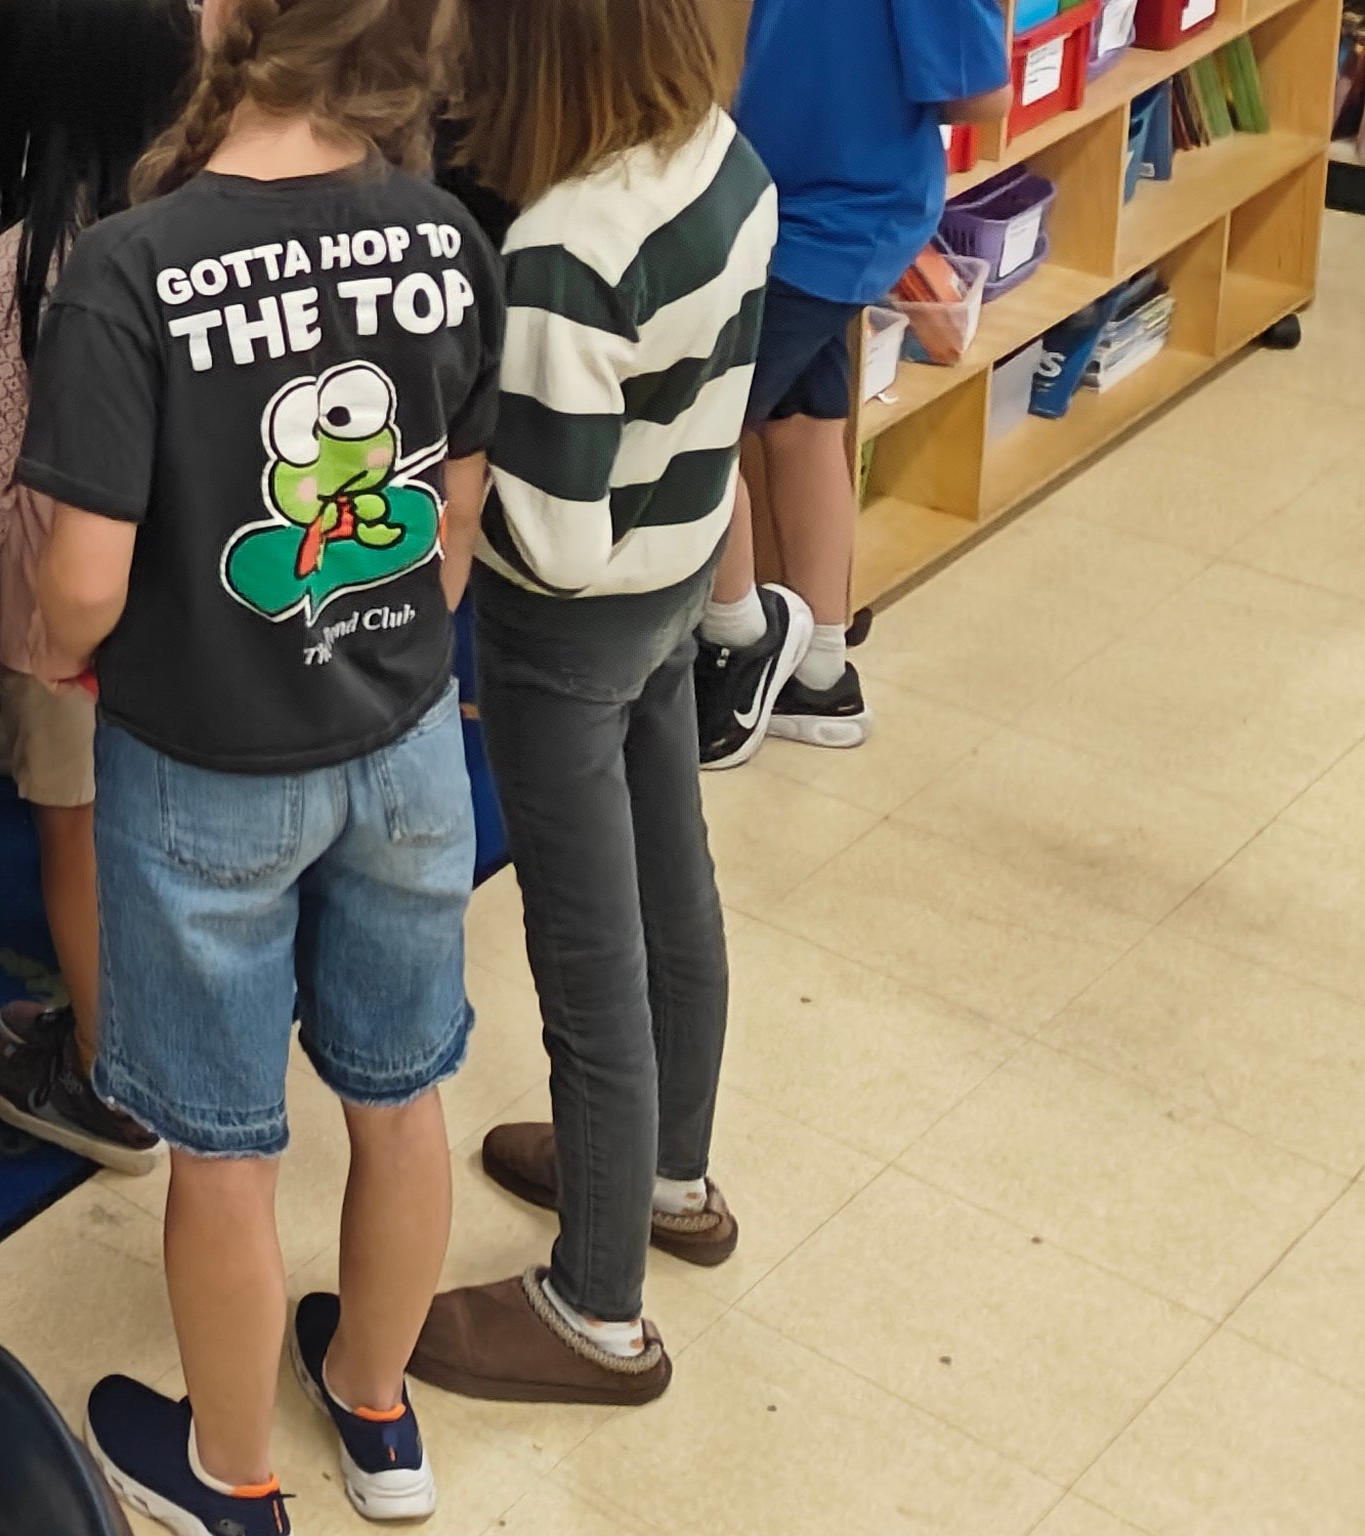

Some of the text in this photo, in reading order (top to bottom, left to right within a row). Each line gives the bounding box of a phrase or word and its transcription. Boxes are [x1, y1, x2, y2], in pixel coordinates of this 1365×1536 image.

[156, 222, 461, 305] GOTTA HOP TO
[168, 268, 475, 372] THE TOP
[361, 603, 416, 631] Club
